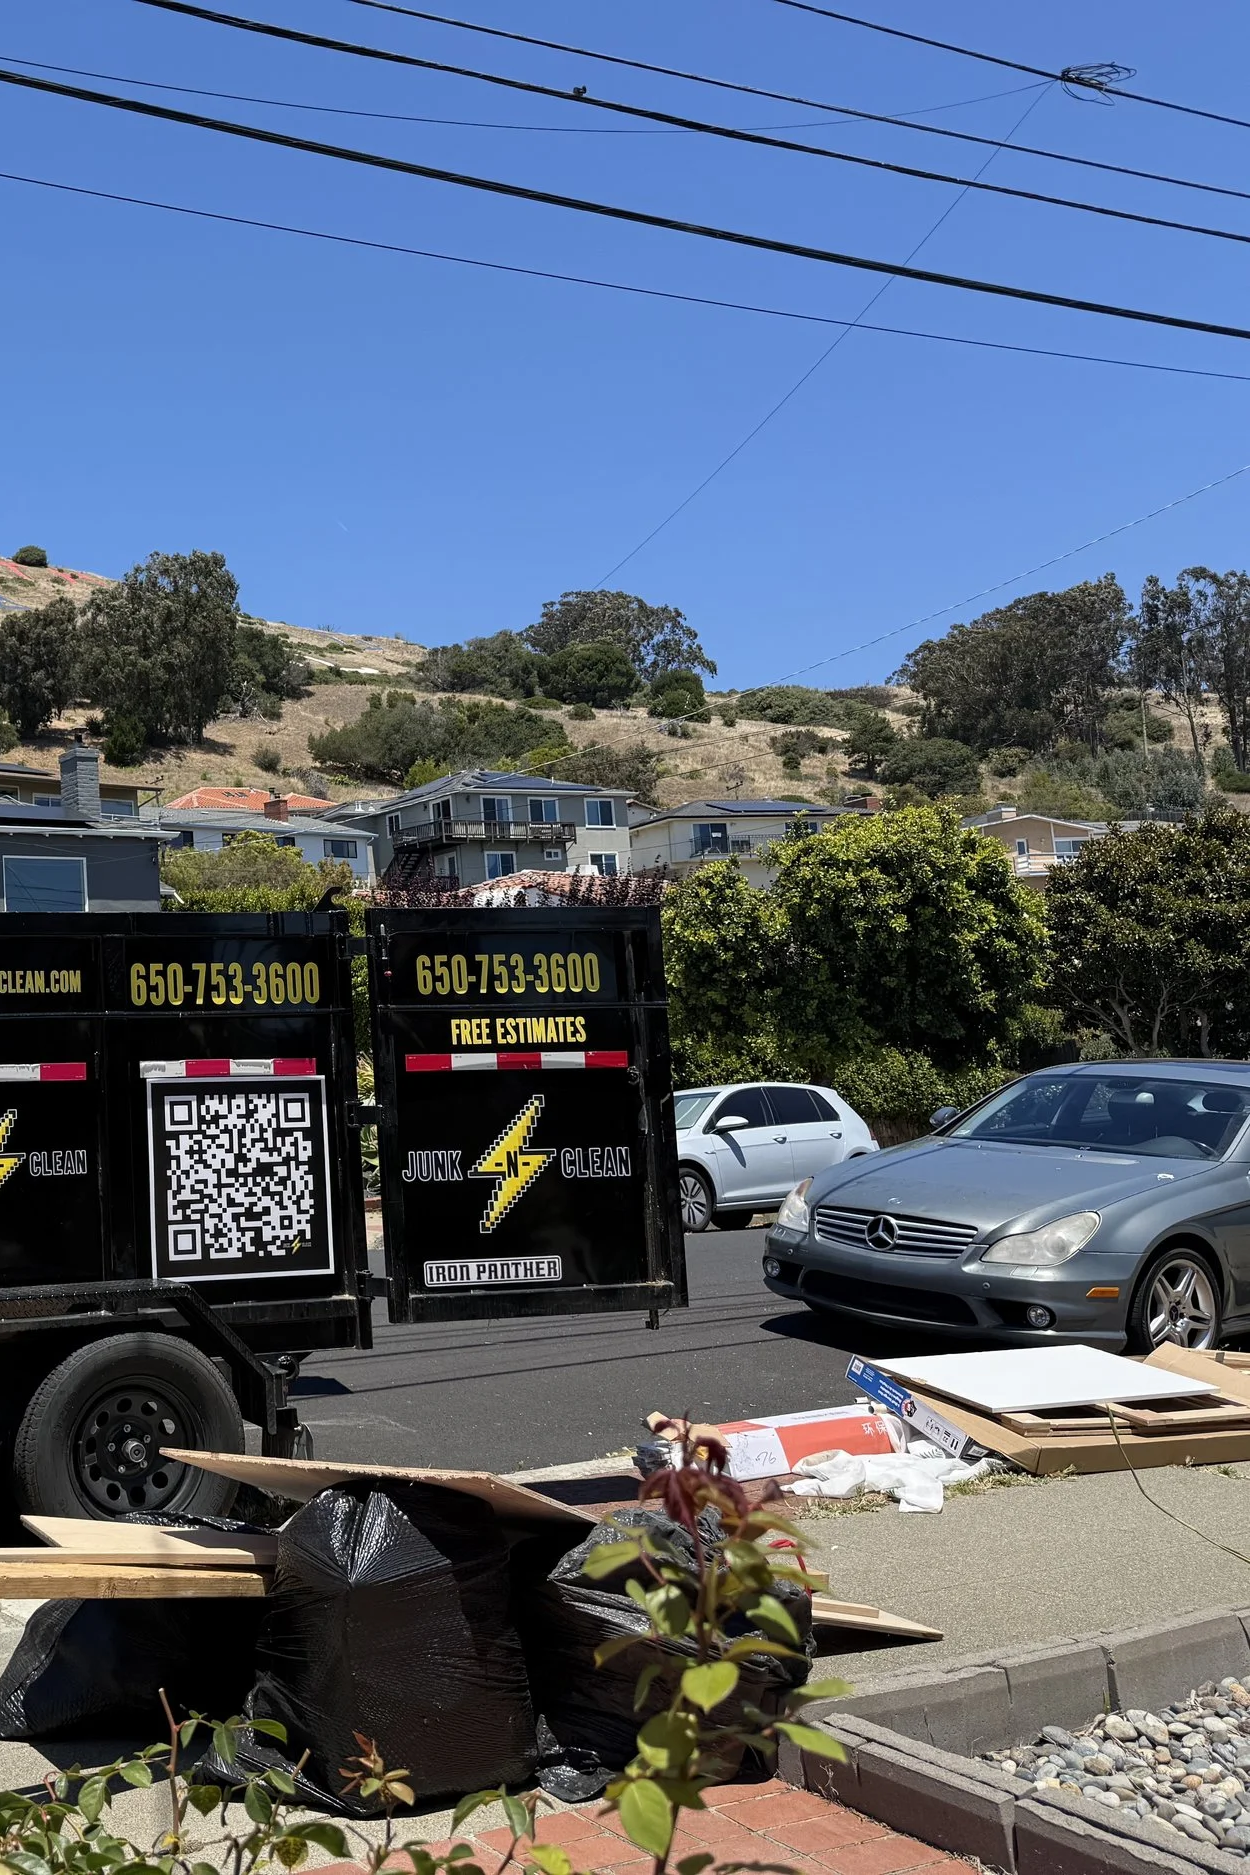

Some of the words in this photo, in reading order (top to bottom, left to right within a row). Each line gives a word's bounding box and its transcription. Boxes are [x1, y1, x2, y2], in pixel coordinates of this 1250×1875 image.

[130, 962, 320, 1006] 650-753-3600
[416, 952, 600, 995] 650-753-3600
[451, 1018, 492, 1045] FREE
[496, 1016, 587, 1044] ESTIMATES
[29, 1150, 88, 1176] CLEAN
[402, 1150, 463, 1182] JUNK
[561, 1147, 631, 1178] CLEAN
[428, 1263, 471, 1283] IRON
[476, 1260, 558, 1280] PANTHER
